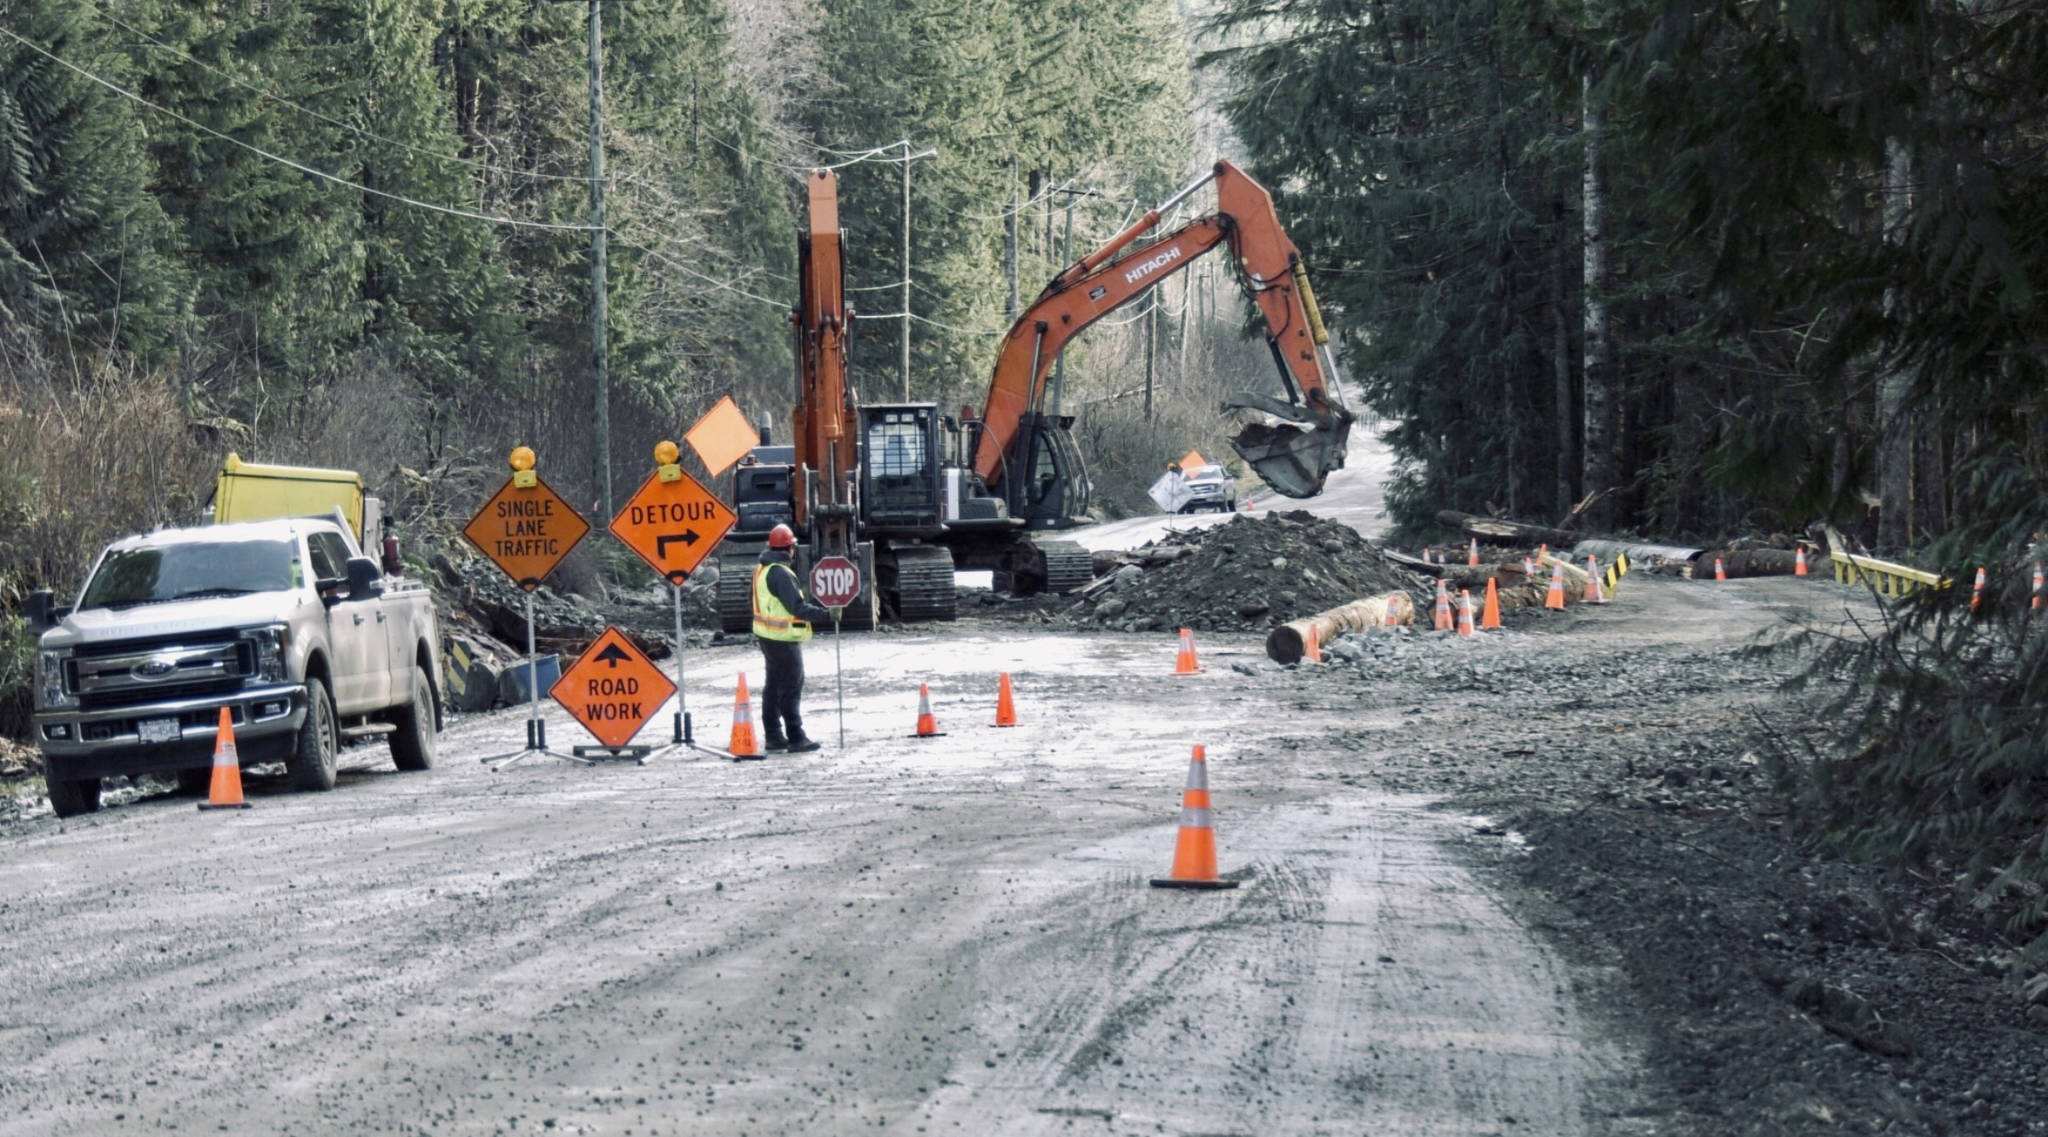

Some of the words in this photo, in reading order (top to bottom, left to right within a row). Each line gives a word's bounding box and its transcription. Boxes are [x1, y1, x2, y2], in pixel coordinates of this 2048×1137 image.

[1125, 247, 1181, 284] HITACHI
[497, 499, 554, 518] SINGLE
[631, 501, 716, 525] DETOUR
[505, 519, 547, 537] LANE
[495, 538, 559, 557] TRAFFIC
[815, 568, 855, 597] STOP
[588, 677, 639, 696] ROAD
[586, 702, 643, 721] WORK
